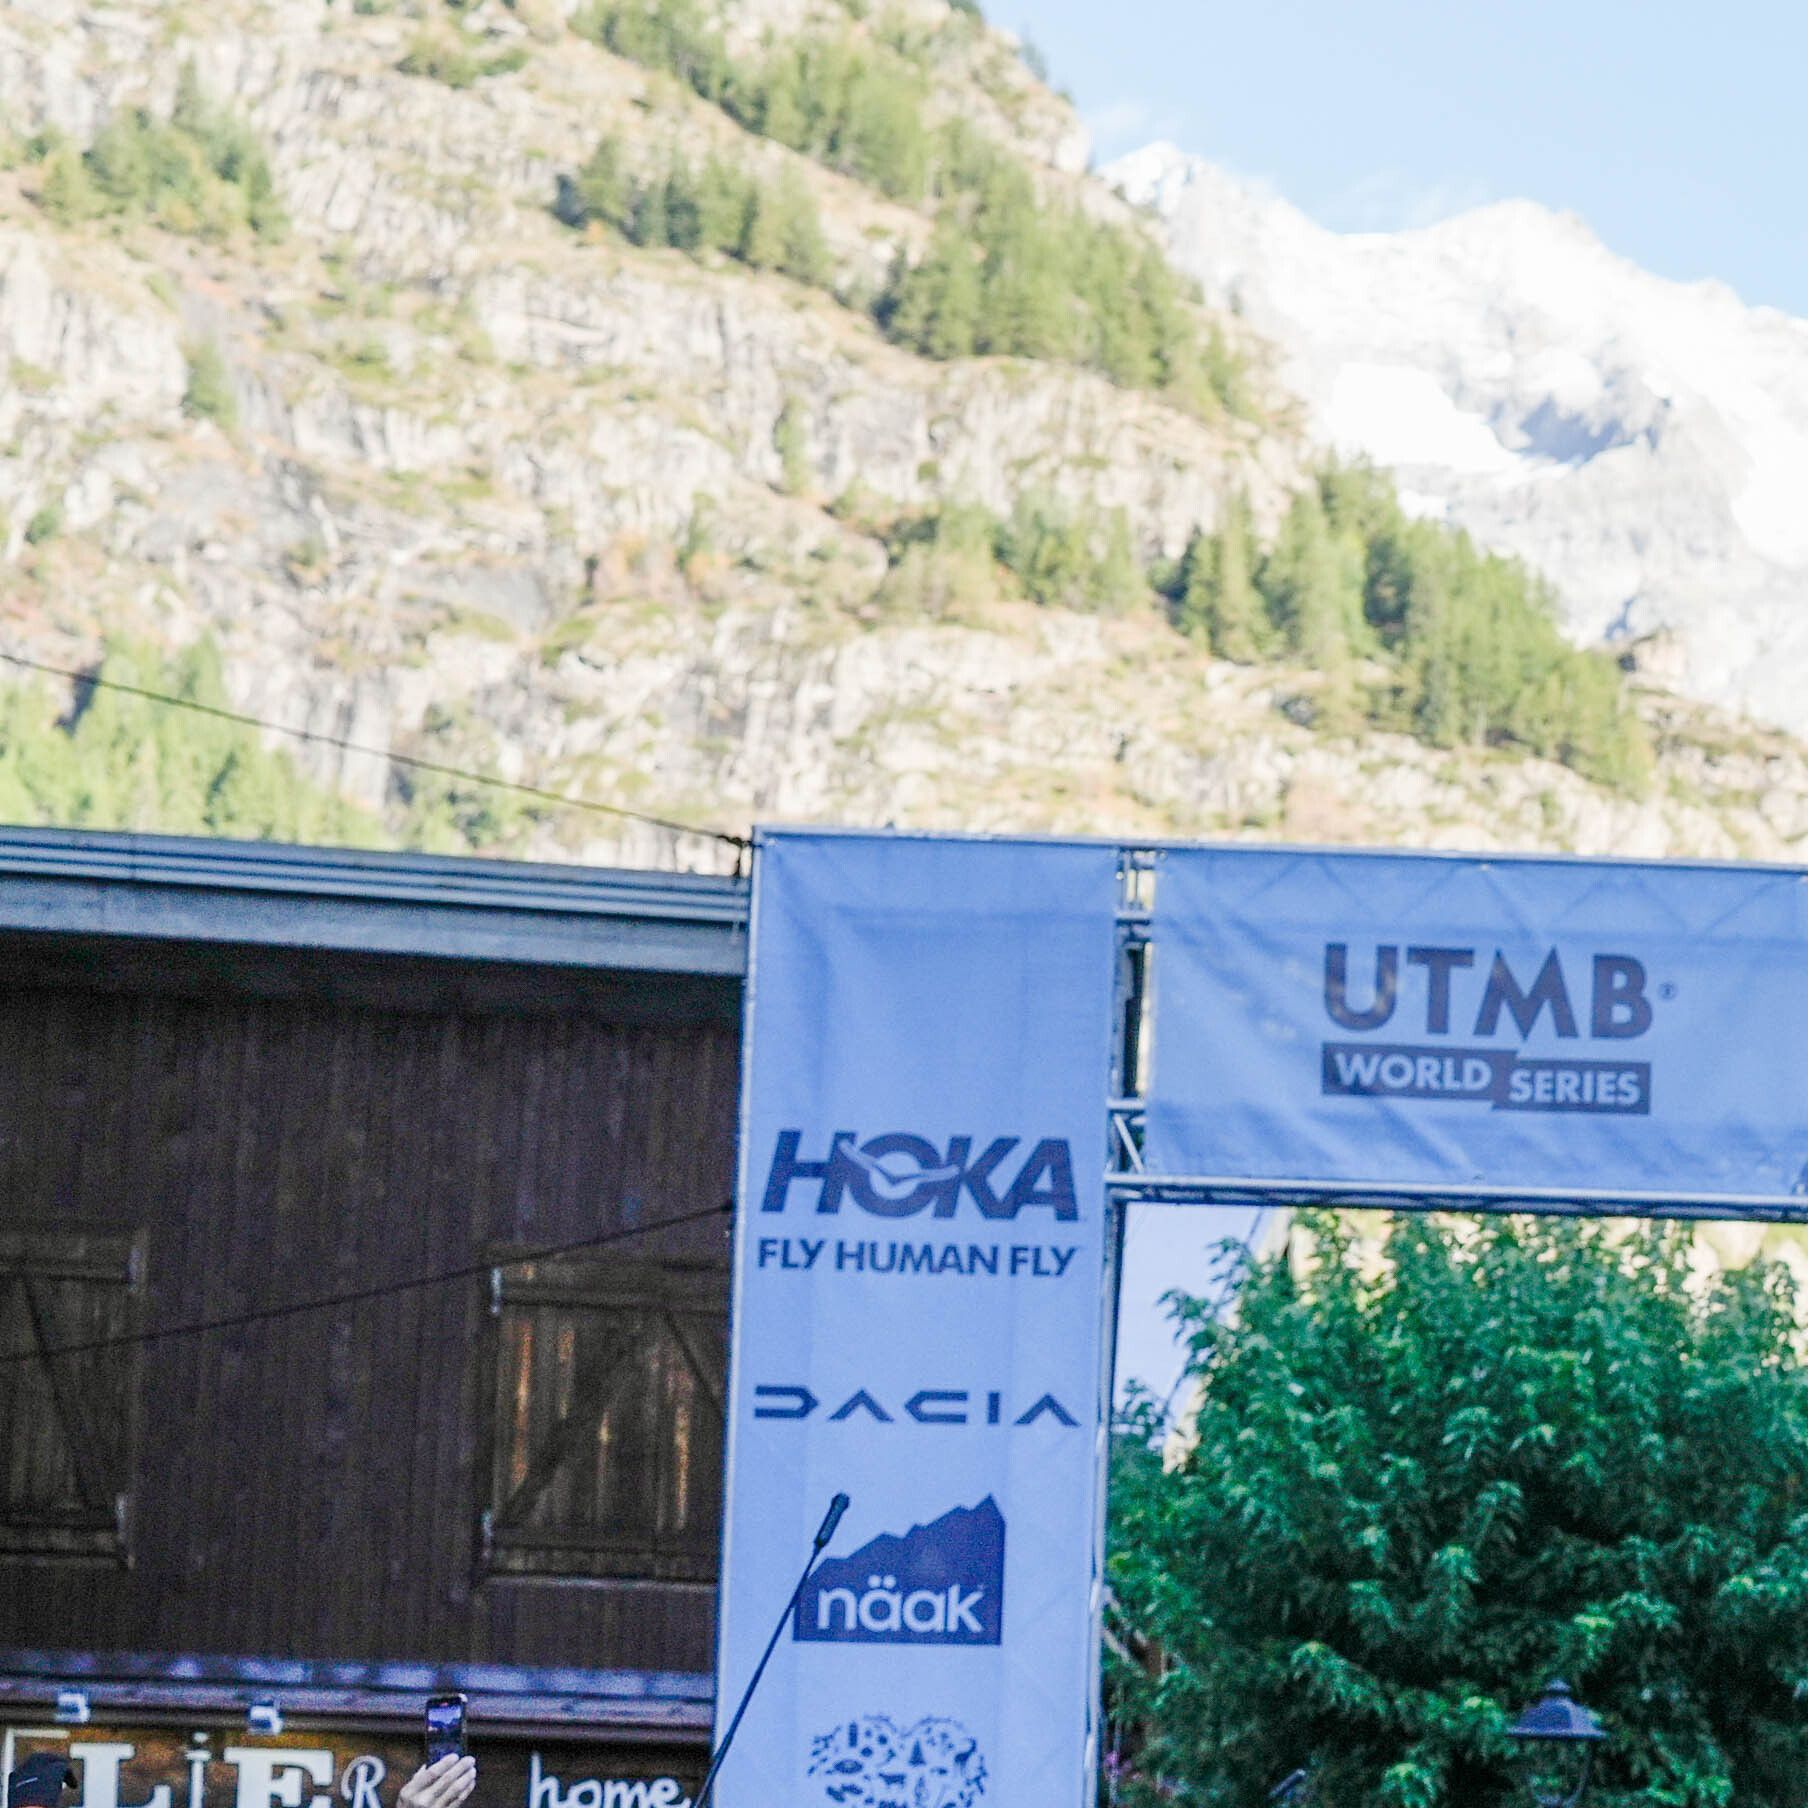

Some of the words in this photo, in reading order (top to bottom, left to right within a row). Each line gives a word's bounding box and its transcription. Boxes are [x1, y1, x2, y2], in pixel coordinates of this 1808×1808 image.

[1323, 942, 1654, 1042] UTMB
[1333, 1052, 1493, 1092] WORLD
[1508, 1068, 1642, 1106] SERIES
[760, 1129, 1079, 1222] HOKA
[757, 1238, 825, 1269] FLY
[834, 1240, 998, 1274] HUMAN
[1009, 1245, 1078, 1277] FLY
[753, 1384, 1083, 1428] DACIA
[816, 1574, 986, 1634] näak
